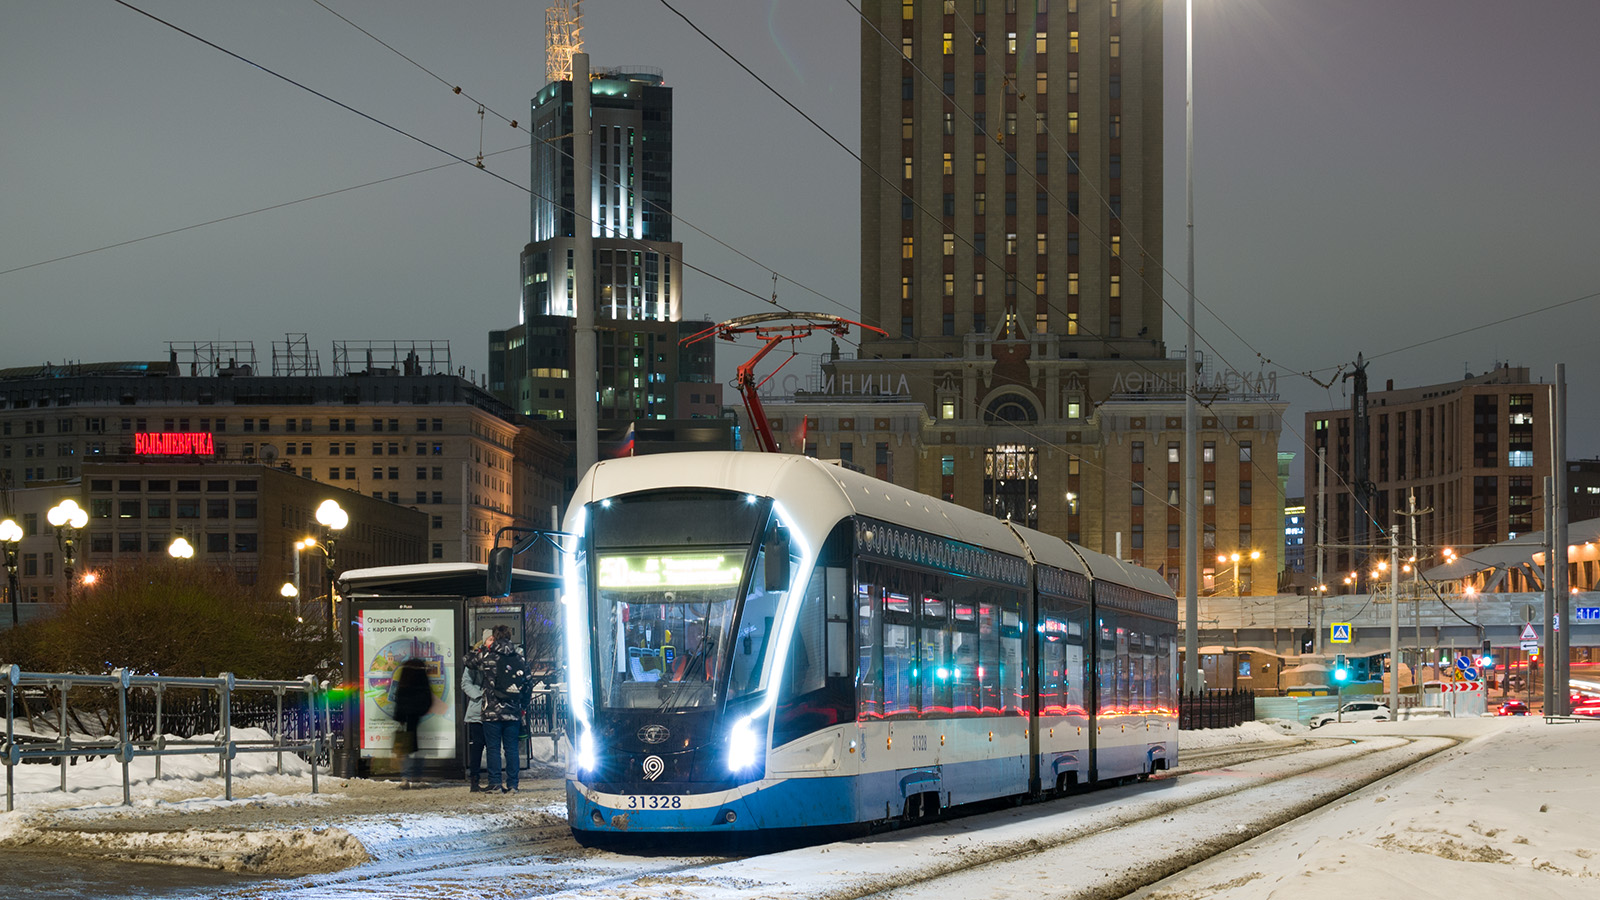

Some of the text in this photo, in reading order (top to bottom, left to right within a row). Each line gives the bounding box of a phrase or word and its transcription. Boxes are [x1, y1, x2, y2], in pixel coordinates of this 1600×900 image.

[757, 373, 910, 396] ОСТИНИЦА
[135, 432, 215, 455] БОЛЬШЕВИЧКА
[367, 617, 431, 625] Открывайте город
[372, 625, 397, 634] картой
[398, 626, 431, 634] «Тройка»
[912, 735, 927, 752] 31328
[628, 796, 681, 809] 31328
